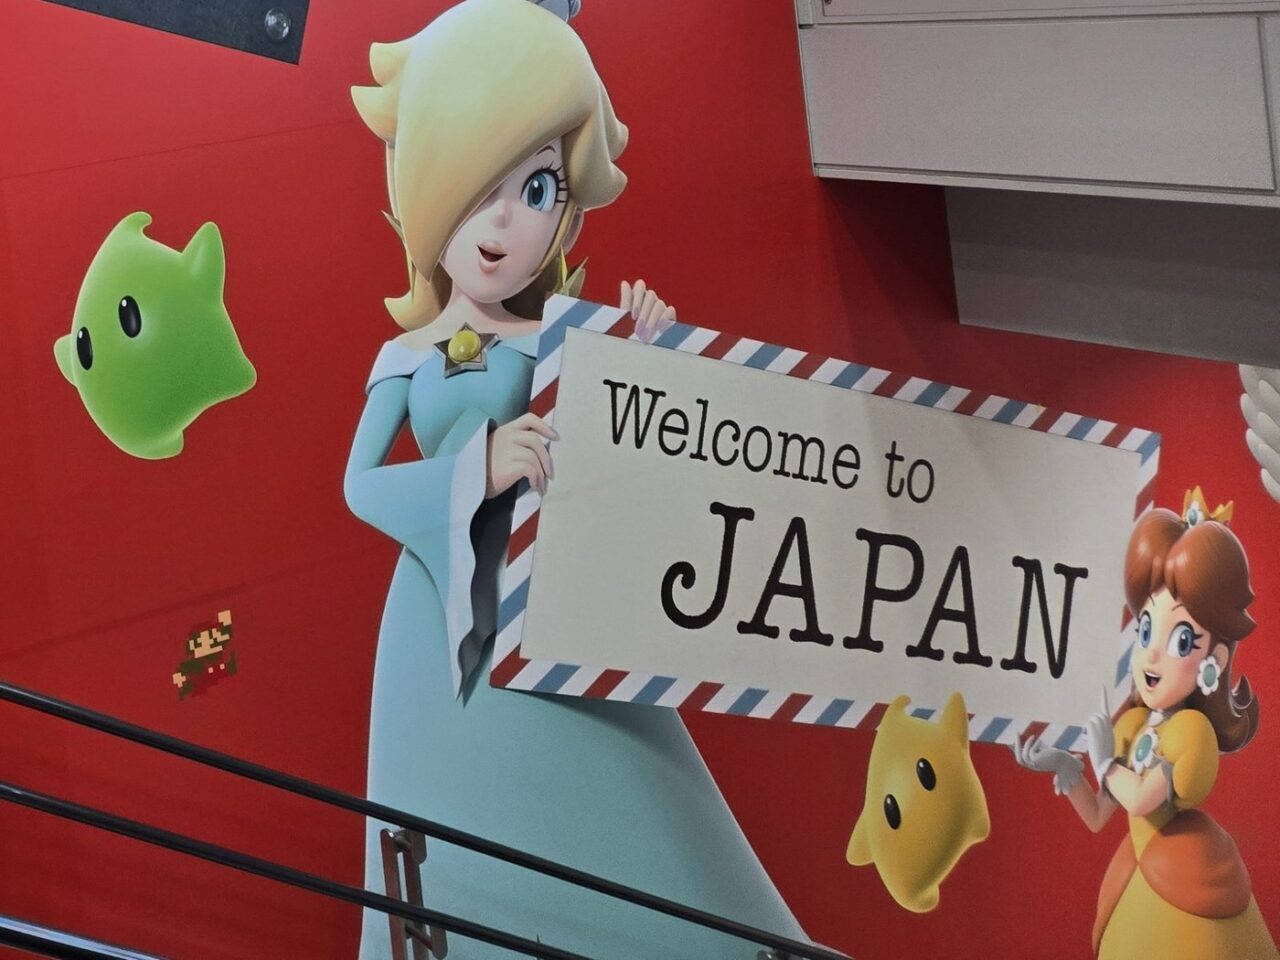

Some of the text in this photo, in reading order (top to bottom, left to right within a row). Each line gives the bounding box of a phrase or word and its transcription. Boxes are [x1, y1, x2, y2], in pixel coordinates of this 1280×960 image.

[603, 379, 935, 503] Welcome to
[661, 502, 1088, 679] JAPAN
